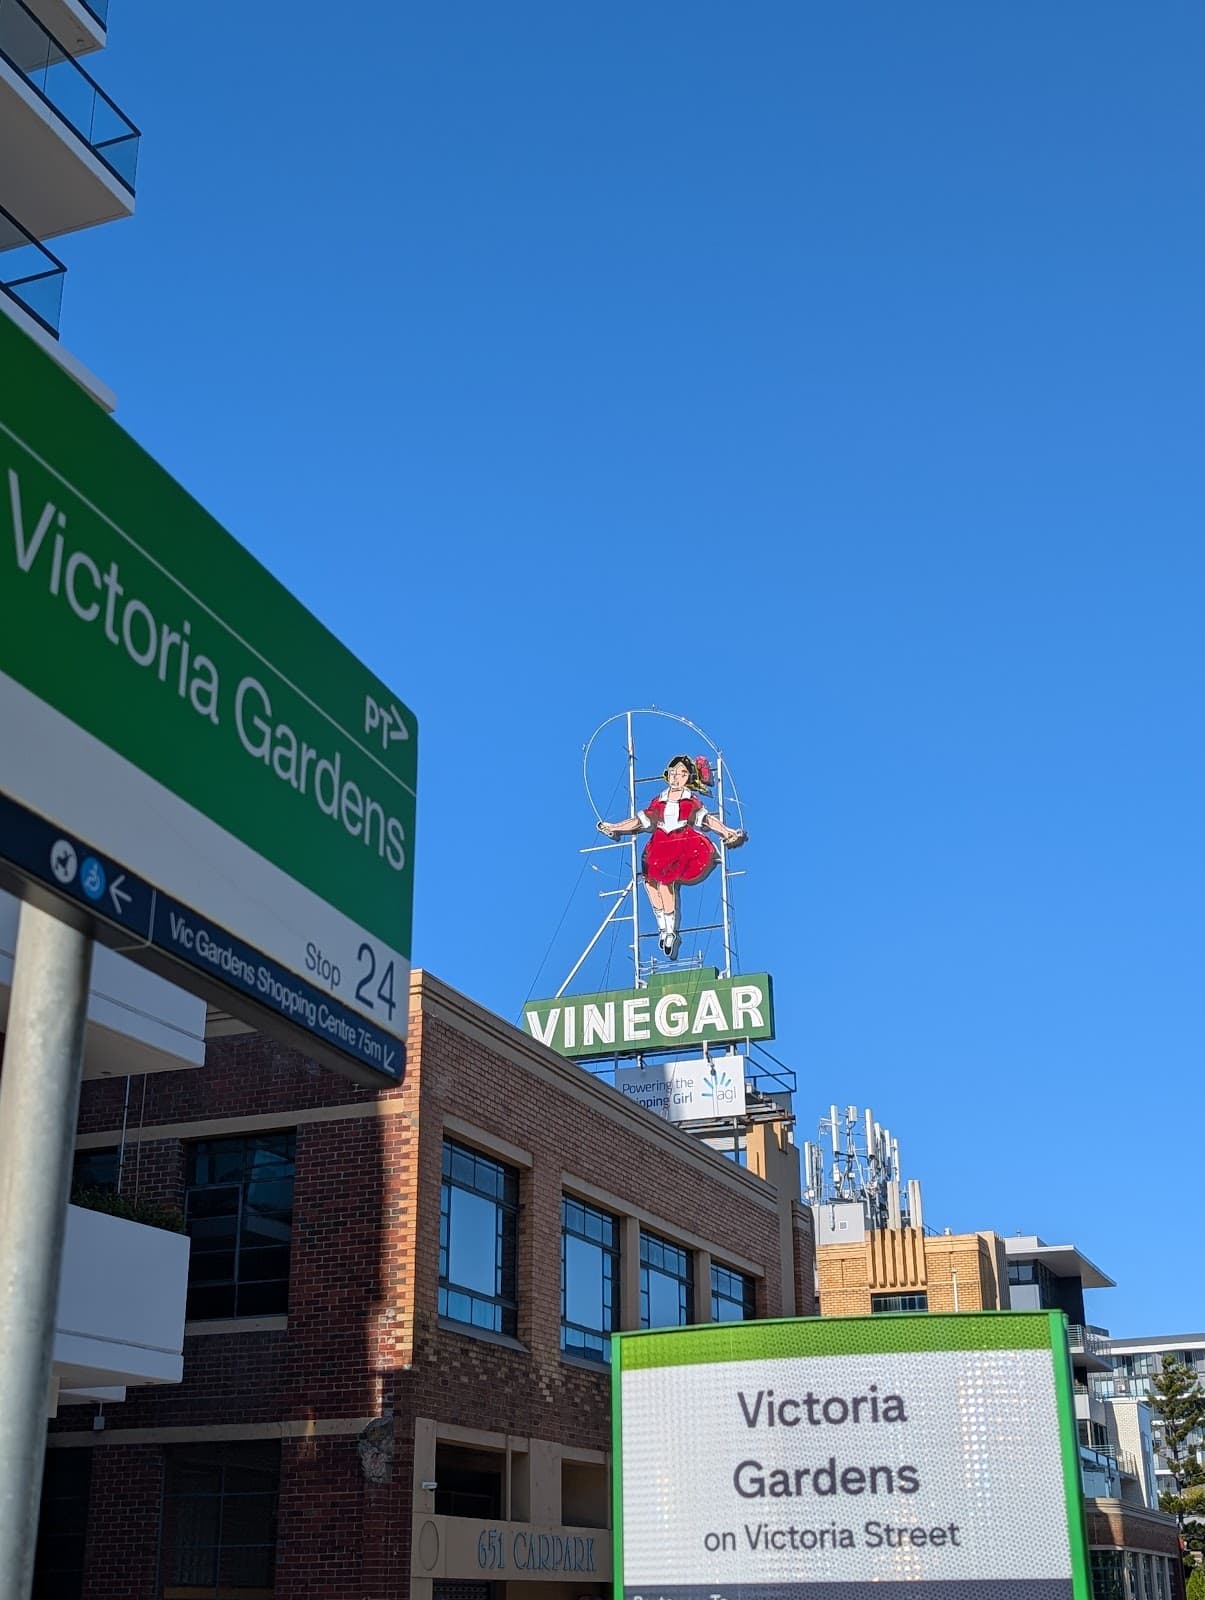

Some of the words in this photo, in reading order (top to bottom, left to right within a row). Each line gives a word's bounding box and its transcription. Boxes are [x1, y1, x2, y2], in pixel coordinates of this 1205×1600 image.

[8, 467, 220, 724] Victoria
[234, 676, 406, 871] Gardens
[169, 911, 194, 948] Vic
[195, 930, 255, 985] Gardens
[256, 966, 317, 1026] Shopping
[318, 1004, 357, 1045] Centre
[358, 1029, 382, 1061] 75m
[305, 942, 341, 990] Stop
[355, 943, 396, 1021] 24
[526, 985, 764, 1048] VINEGAR
[622, 1080, 674, 1095] Powering
[676, 1077, 694, 1089] the
[673, 1092, 693, 1105] Girl
[717, 1086, 737, 1103] agl
[737, 1384, 909, 1429] Victoria
[733, 1457, 921, 1499] Gardens
[477, 1528, 504, 1570] 651
[513, 1530, 597, 1573] CARPARK
[704, 1530, 736, 1552] on
[744, 1522, 855, 1550] Victoria
[864, 1520, 961, 1549] Street
